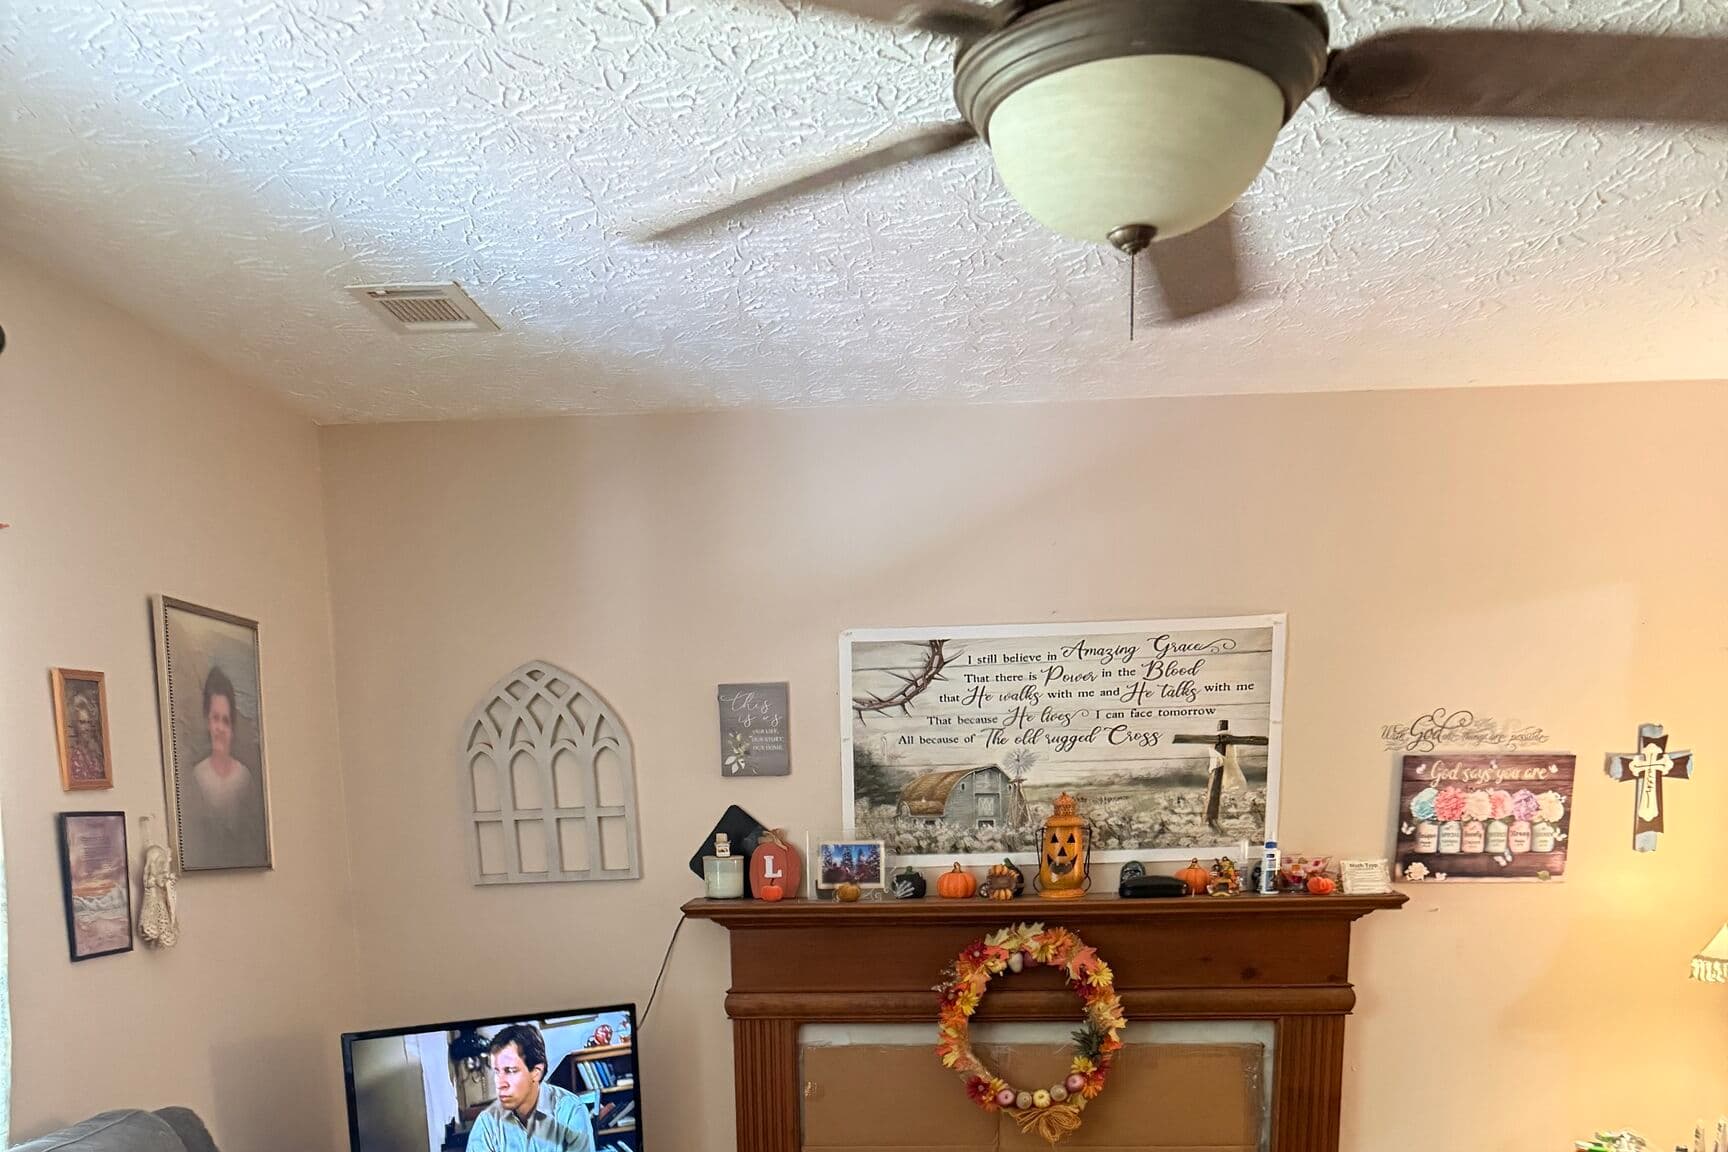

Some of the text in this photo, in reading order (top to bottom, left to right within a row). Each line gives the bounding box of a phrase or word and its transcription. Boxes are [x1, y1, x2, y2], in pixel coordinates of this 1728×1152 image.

[967, 634, 1236, 665] I still believe in Amazing Grace
[963, 659, 1206, 687] That there is Power in the Blood
[939, 679, 1255, 709] that He walks with me and He talks with me
[926, 705, 1217, 730] That because He lives I can face tomorrow
[1407, 707, 1474, 752] God
[898, 724, 1164, 753] All because of The old rugged Cross
[1429, 760, 1548, 788] God says you are
[763, 855, 783, 878] L
